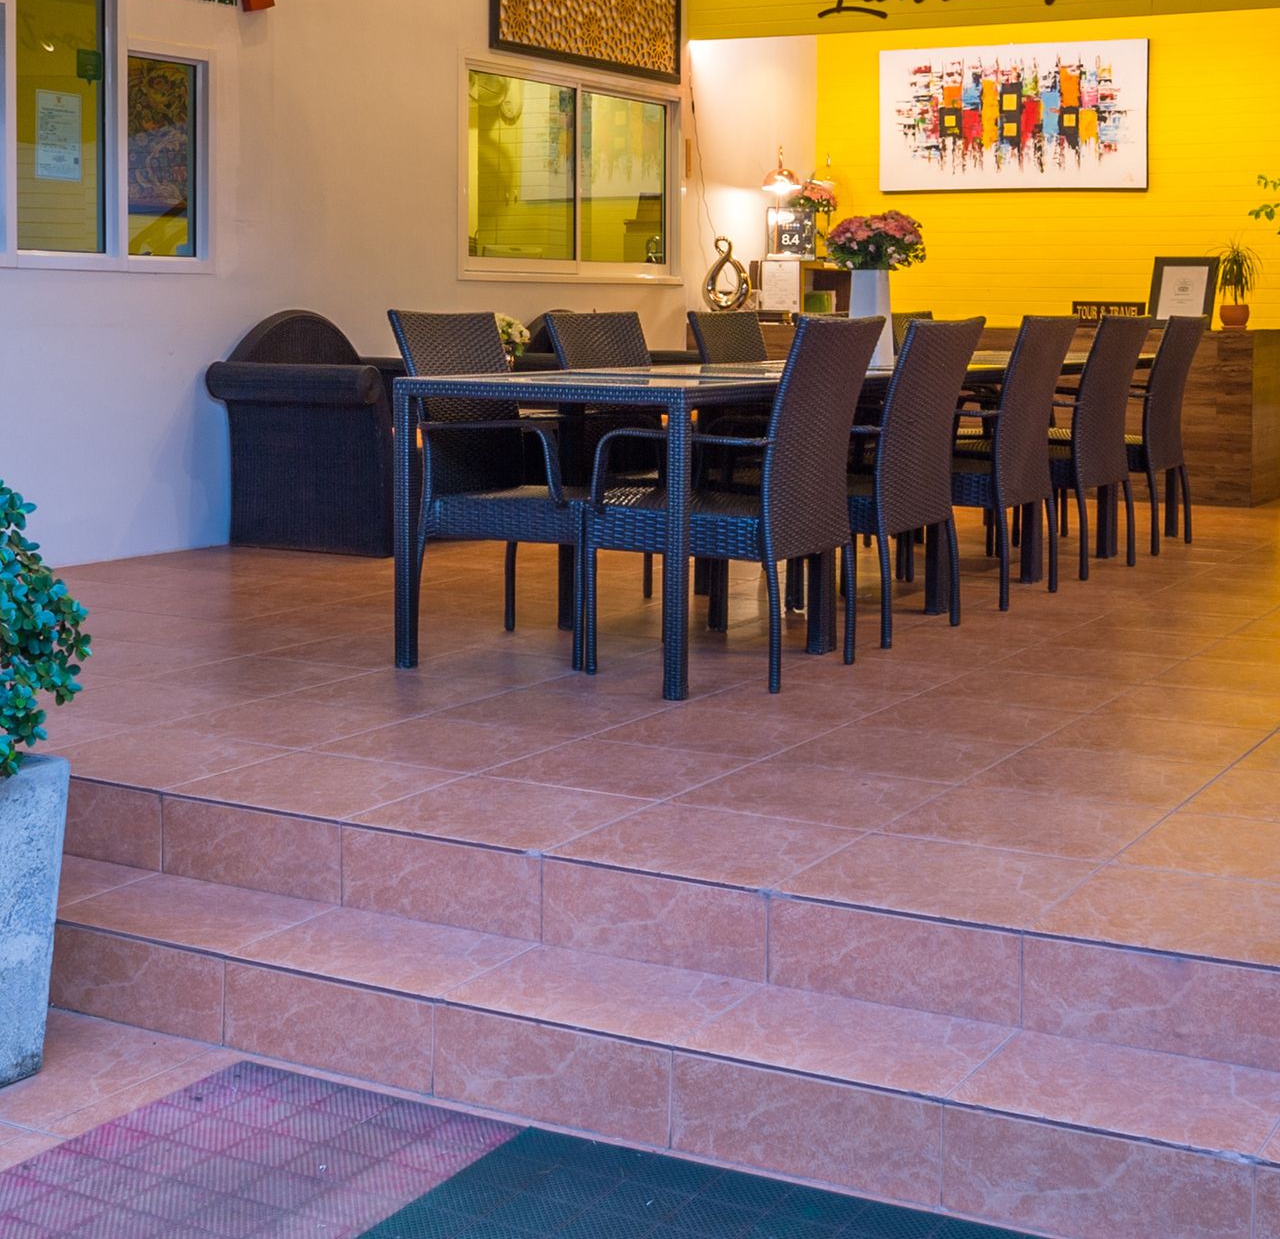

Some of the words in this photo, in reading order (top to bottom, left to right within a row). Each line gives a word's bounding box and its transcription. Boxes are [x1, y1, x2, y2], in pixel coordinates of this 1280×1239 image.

[781, 234, 800, 246] 8.4
[1076, 306, 1097, 320] TOUR
[1100, 306, 1107, 319] &
[1109, 306, 1139, 317] TRAVEL
